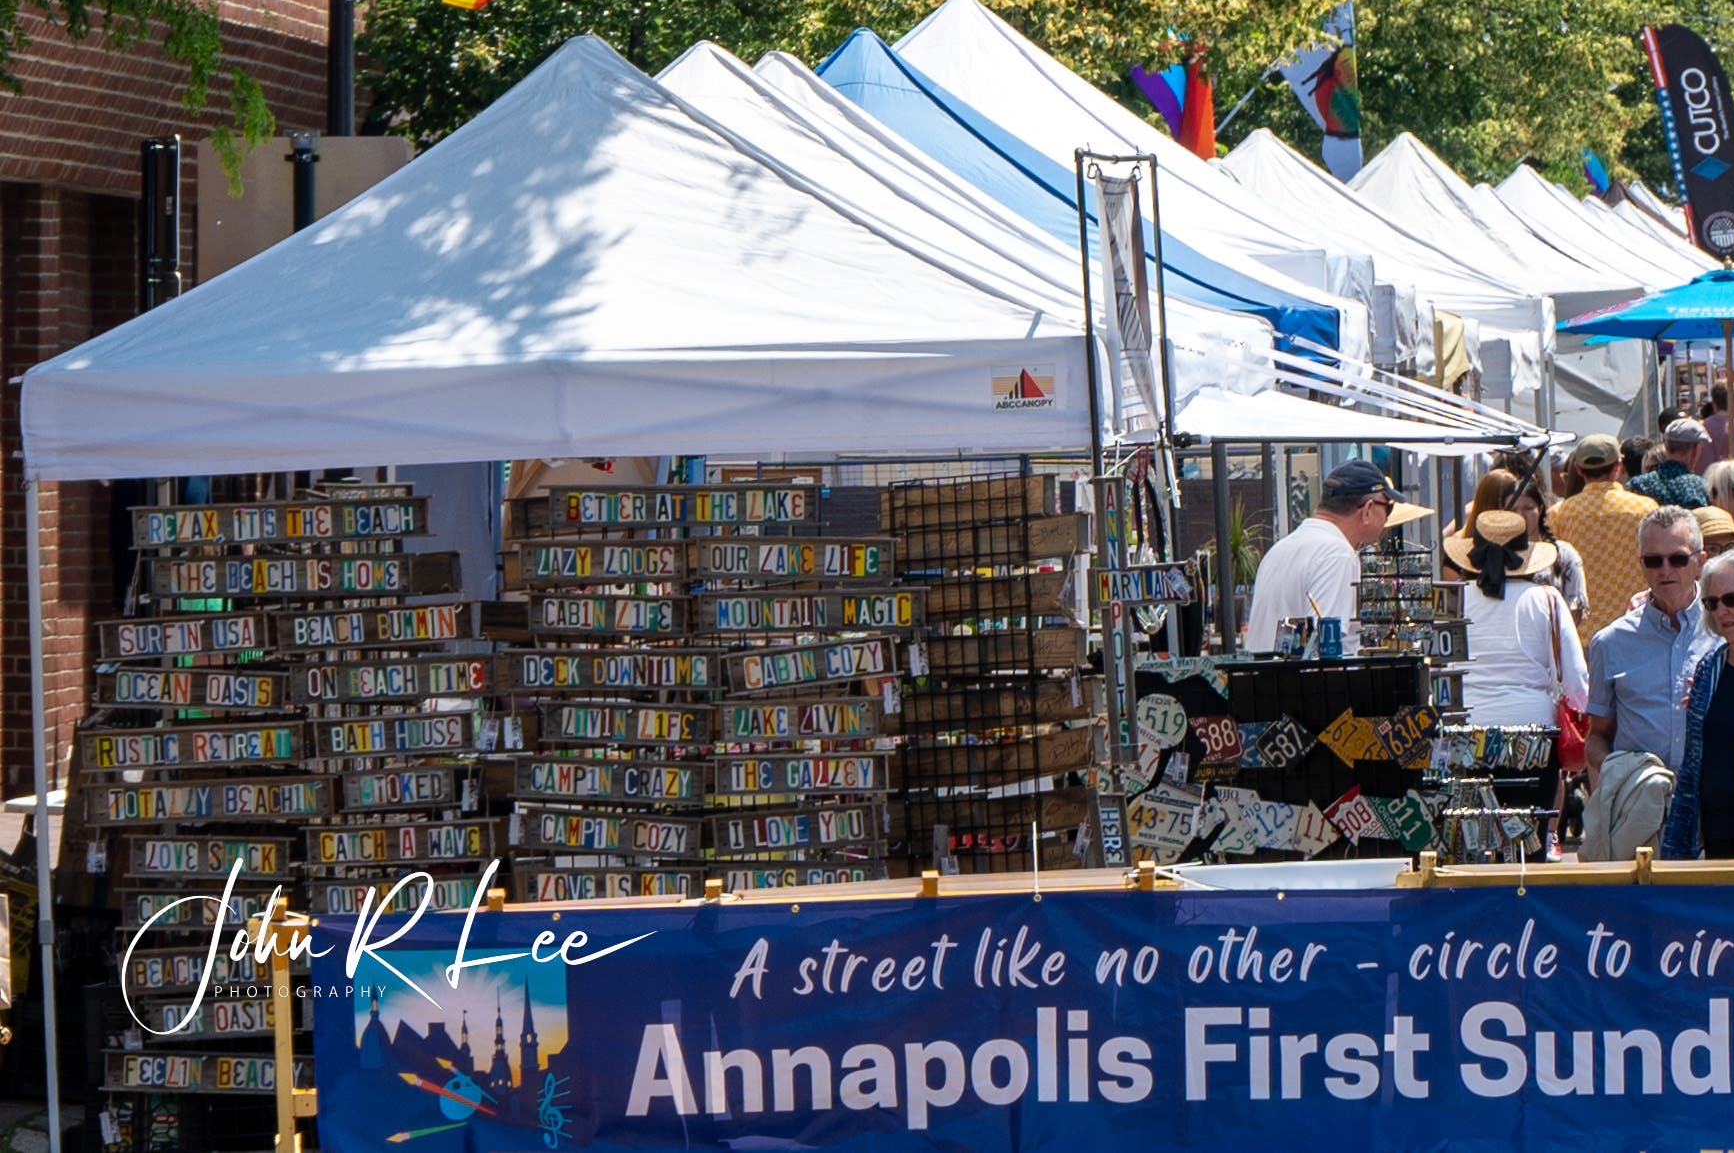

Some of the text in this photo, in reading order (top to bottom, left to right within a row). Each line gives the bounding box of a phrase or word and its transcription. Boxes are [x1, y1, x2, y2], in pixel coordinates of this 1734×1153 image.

[1680, 67, 1720, 155] CUTCO
[995, 399, 1054, 410] ABCCANOPY
[287, 506, 331, 537] THE
[343, 505, 414, 536] BEACH
[566, 490, 805, 523] BETTER AT THE LAKE
[171, 561, 215, 593] THE
[227, 560, 296, 591] BEACH
[342, 559, 398, 590] HOME
[536, 547, 674, 576] LAZY LODGE
[710, 546, 749, 573] OUR
[759, 546, 815, 575] LAKE
[1099, 570, 1176, 603] MARYLAN
[213, 617, 254, 647] USA
[294, 614, 364, 646] BEACH
[524, 655, 579, 686] DECK
[824, 641, 884, 678] COZY
[116, 672, 191, 703] OCEAN
[307, 668, 337, 698] ON
[350, 666, 418, 695] BEACH
[331, 716, 462, 752] BATH HOUSE
[736, 707, 788, 737] LAKE
[193, 728, 291, 762] RETREAT
[359, 772, 443, 806] STOKED
[624, 767, 691, 797] CRAZY
[731, 758, 873, 790] THE GALLEY
[108, 787, 211, 819] TOTALLY
[320, 826, 481, 862] CATCH A WAVE
[632, 821, 687, 852] COZY
[729, 810, 864, 849] I LOVE YOU
[145, 842, 198, 872] LOVE
[537, 874, 595, 900] LOVE
[203, 894, 266, 924] SAC
[134, 956, 203, 987] BEACH
[729, 937, 769, 1000] A
[793, 934, 958, 995] street
[974, 925, 1066, 989] like
[1095, 945, 1159, 987] no
[1187, 925, 1328, 984] other
[1408, 917, 1558, 980] circle
[1586, 922, 1632, 978] to
[217, 1057, 302, 1089] BEACY
[625, 1007, 1154, 1130] Annapolis
[1184, 1005, 1430, 1102] First
